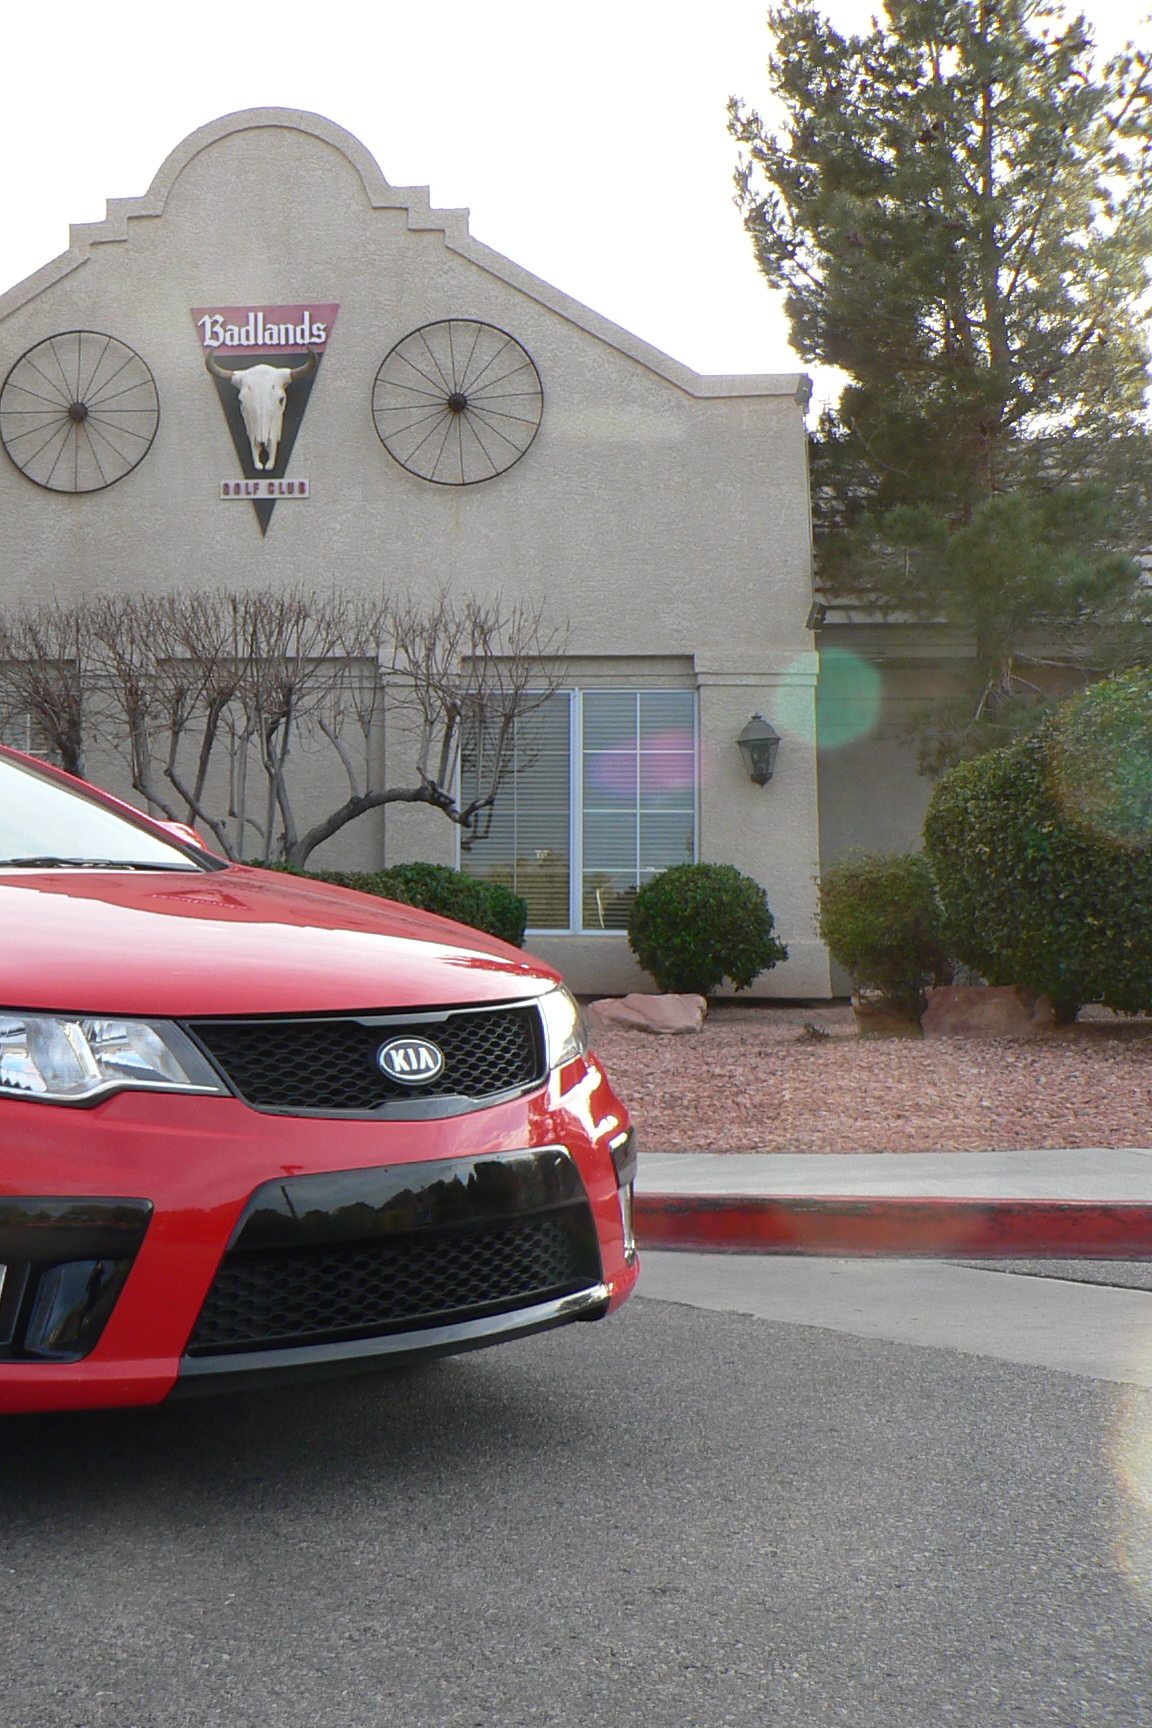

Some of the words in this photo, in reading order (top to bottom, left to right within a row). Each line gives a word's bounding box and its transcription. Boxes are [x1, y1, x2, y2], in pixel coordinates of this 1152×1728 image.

[197, 310, 327, 348] Badlands
[222, 482, 260, 495] GOLF
[268, 482, 306, 495] CLUB
[388, 1047, 435, 1072] KIA
